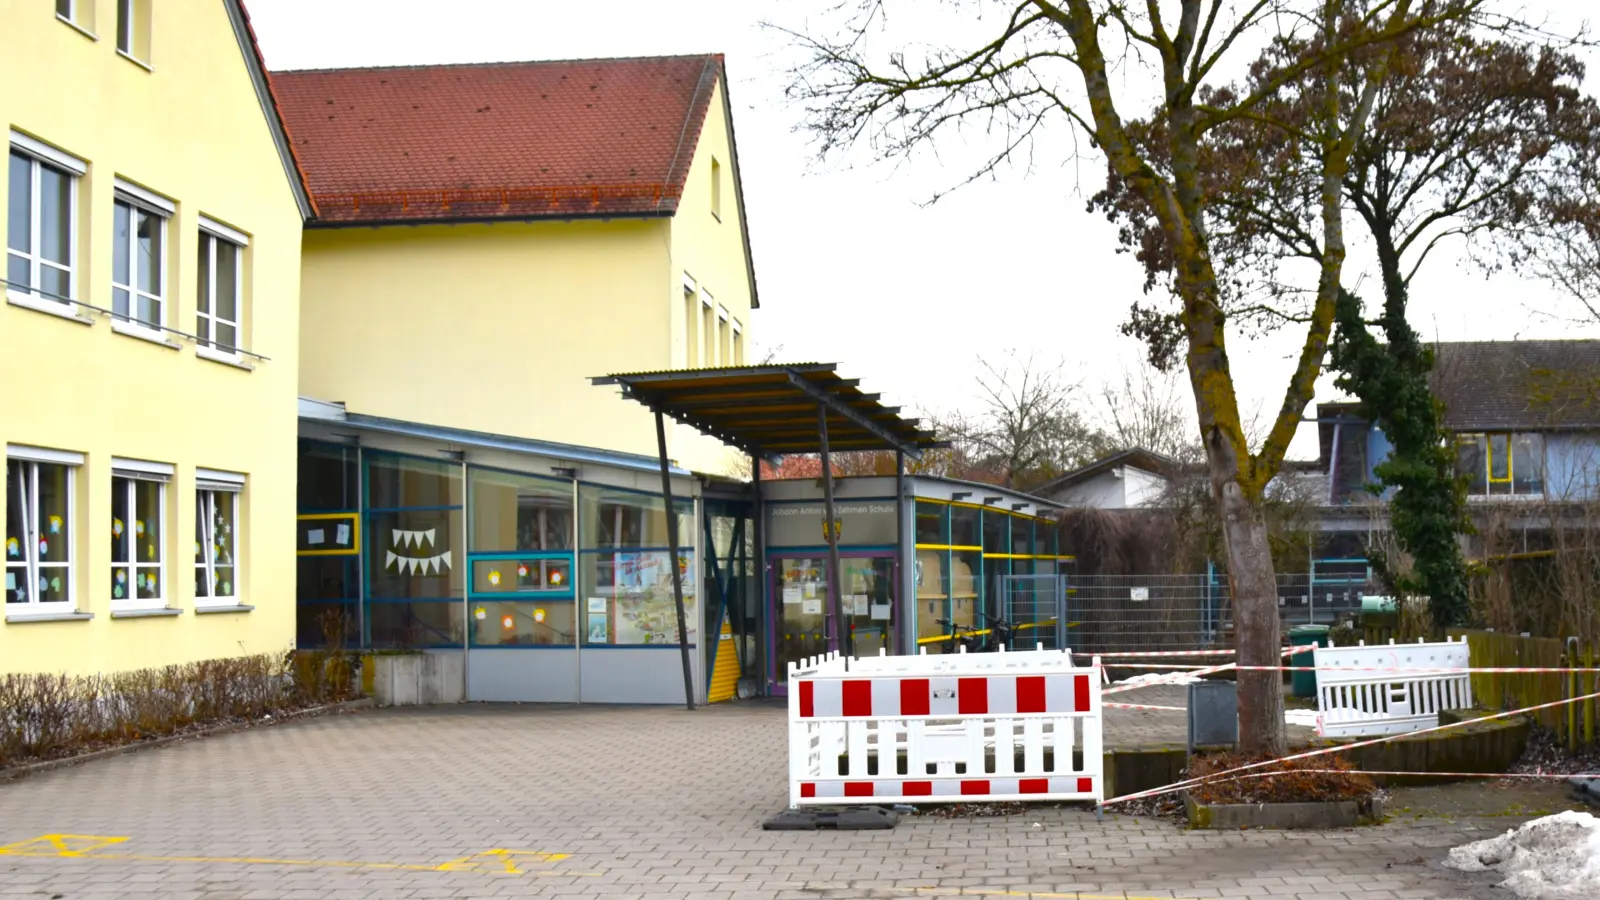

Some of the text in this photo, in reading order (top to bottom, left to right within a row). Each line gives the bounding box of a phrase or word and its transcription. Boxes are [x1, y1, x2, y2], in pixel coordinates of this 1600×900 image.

[772, 508, 798, 516] Johann
[800, 507, 821, 515] Anton
[823, 507, 837, 515] vn
[869, 503, 895, 514] Schule
